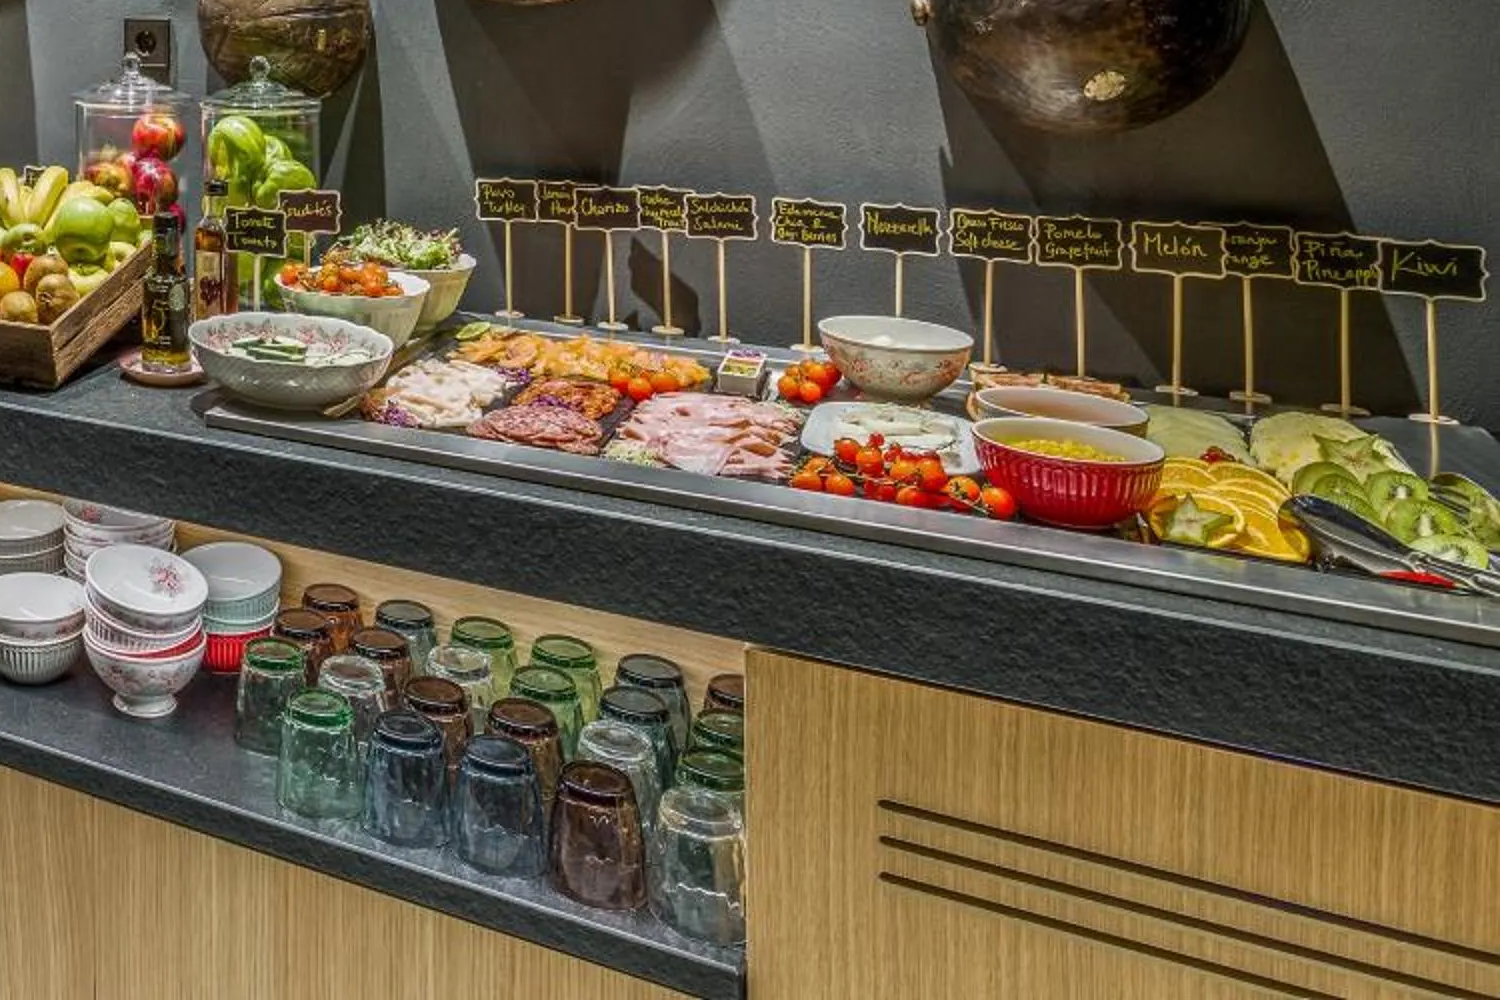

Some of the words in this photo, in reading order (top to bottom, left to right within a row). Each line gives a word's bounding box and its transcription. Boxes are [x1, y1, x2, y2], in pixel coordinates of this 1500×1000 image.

[581, 197, 629, 216] Chorizo
[1043, 222, 1103, 240] Pomelo
[1045, 241, 1112, 260] Grapefruit
[1143, 231, 1208, 257] Melón
[1304, 240, 1363, 258] Piña
[1226, 254, 1275, 269] range
[1391, 247, 1459, 282] Kiwi
